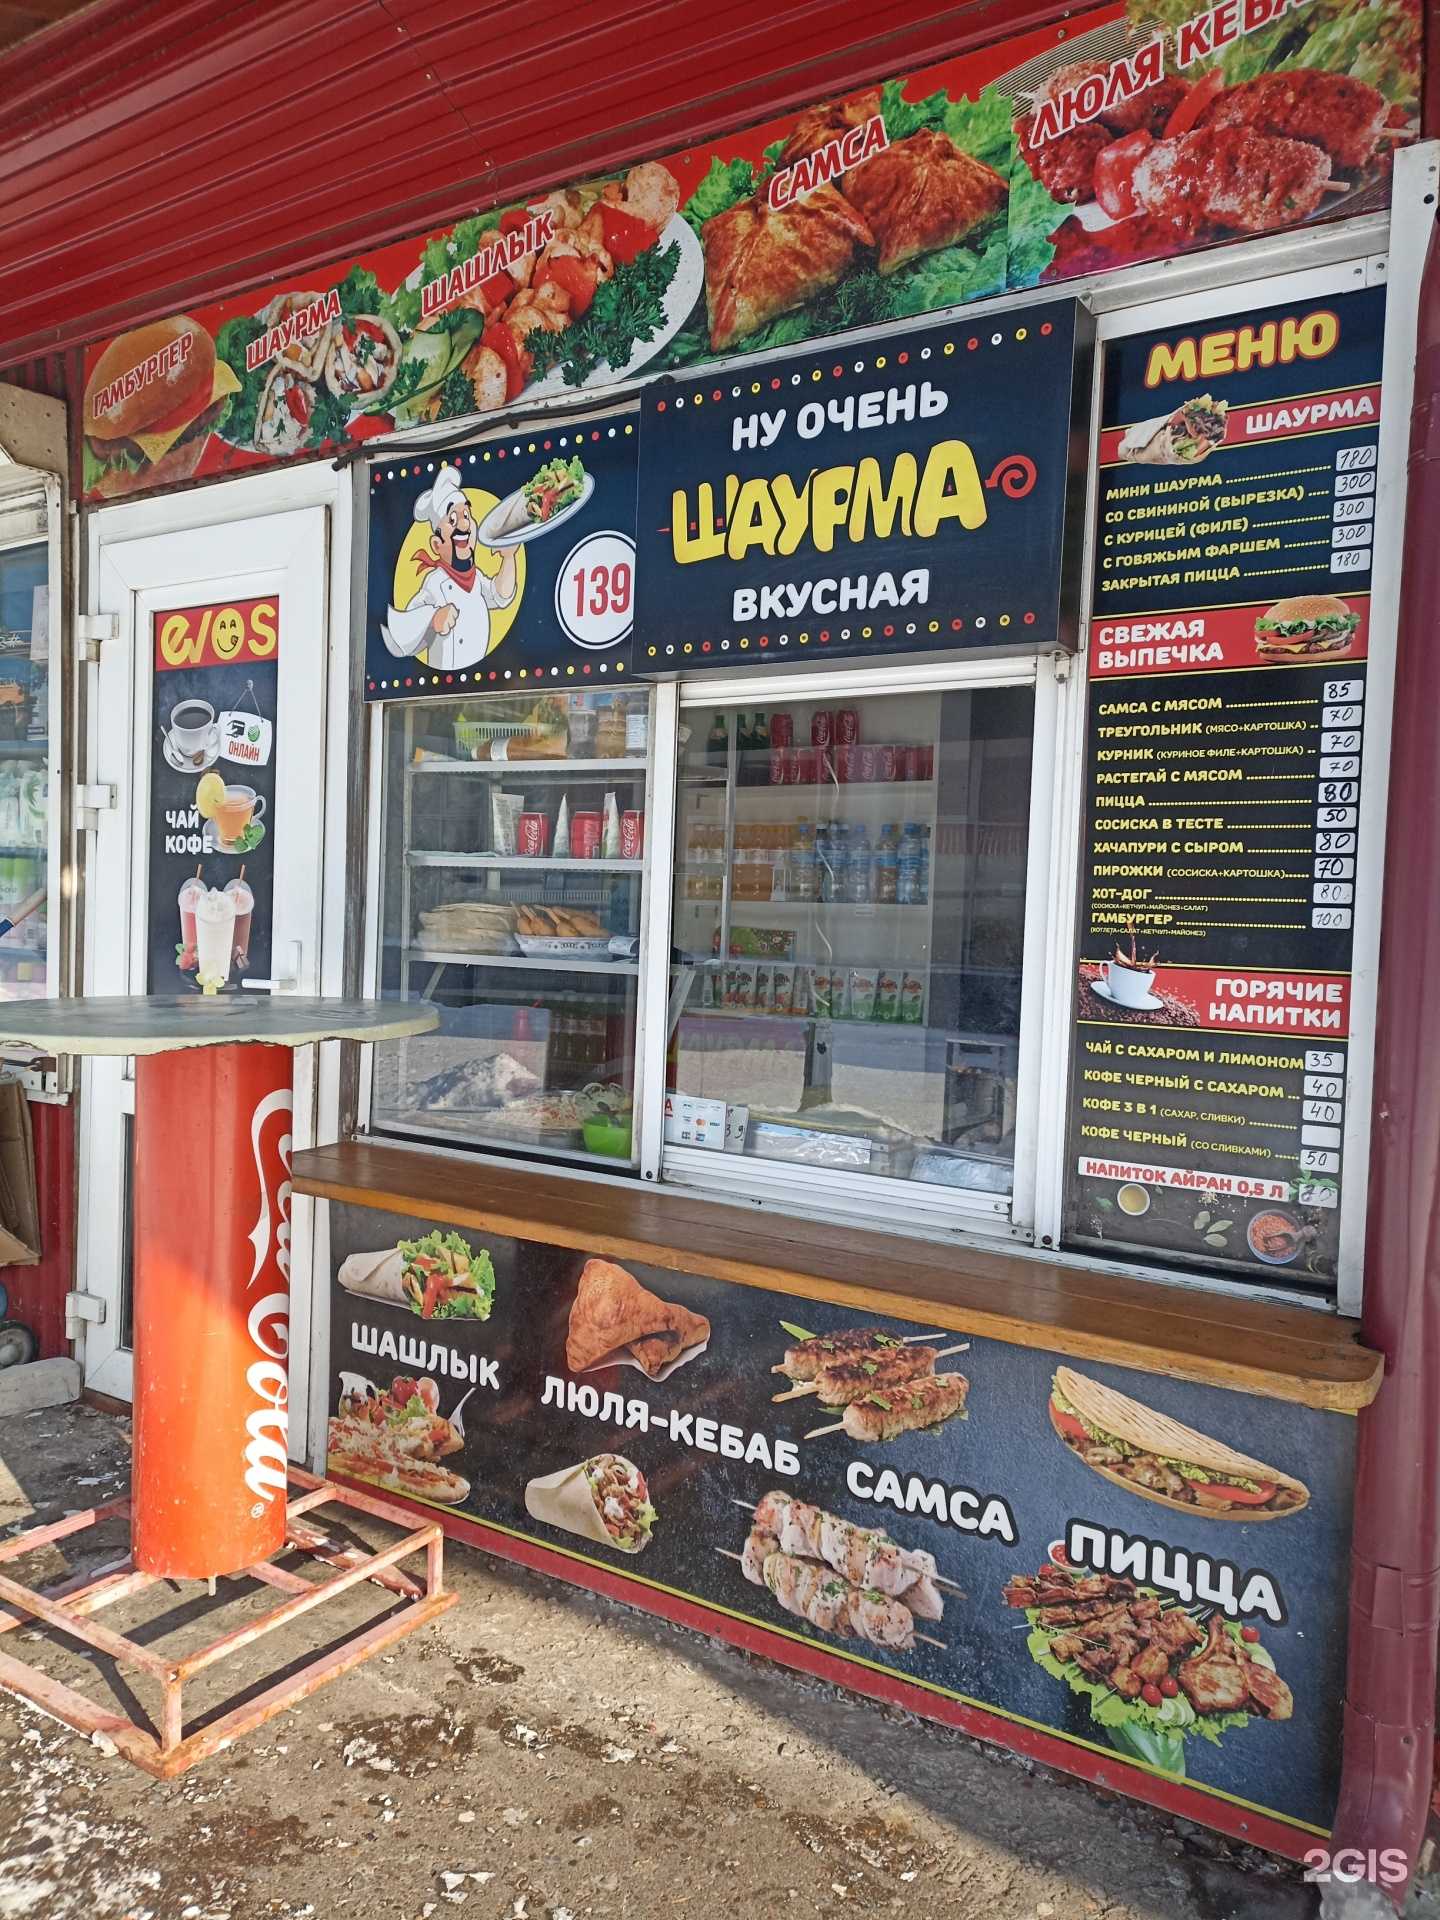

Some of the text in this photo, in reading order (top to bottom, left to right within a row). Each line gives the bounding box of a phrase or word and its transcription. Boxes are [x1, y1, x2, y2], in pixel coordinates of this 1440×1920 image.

[1029, 41, 1164, 148] ЛЮЛЯ
[767, 116, 888, 210] САМСА
[421, 211, 554, 316] ШАШЛЫК
[246, 290, 342, 372] ШАУРМА
[1145, 311, 1338, 388] МЕНЮ
[93, 332, 193, 418] ГАМБУРГЕР
[732, 381, 949, 451] НУ ОЧЕНЬ
[1246, 396, 1374, 434] ШАУРМА
[1106, 448, 1371, 500] МИНИ ШАУРМА 180
[673, 439, 988, 564] ШАУРМА
[1105, 473, 1371, 523] СО СВИНИНОЙ (ВЫРЕЗКА) 300
[1104, 501, 1364, 545] С КУРИЦЕЙ (ФИЛЕ) 300
[1103, 525, 1366, 568] С ГОВЯЖЬИМ ФАРШЕМ 300
[573, 562, 631, 617] 139
[1102, 552, 1360, 591] ЗАКРЫТАЯ ПИЦЦА 180
[732, 568, 929, 622] ВКУСНАЯ
[1099, 619, 1205, 645] СВЕЖАЯ
[1098, 642, 1224, 669] ВЫПЕЧКА
[1099, 682, 1351, 715] САМСА С МЯСОМ 85
[1097, 707, 1354, 738] ТРЕУГОЛЬНИК (МЯСО+КАРТОШКА) 70
[228, 740, 260, 762] ОНЛАЙН
[1097, 734, 1355, 761] КУРНИК (КУРИНОЕ ФИЛЕ+КАРТОШКА) 70
[1096, 760, 1354, 784] РАСТЕГАЙ С МЯСОМ 70
[1096, 783, 1352, 808] ПИЦЦА 80
[165, 804, 200, 829] ЧАЙ
[1095, 808, 1347, 830] СОСИСКА В ТЕСТЕ 50
[165, 835, 214, 854] КОФЕ
[1094, 833, 1350, 853] ХАЧАПУРИ С СЫРОМ 80
[1094, 858, 1344, 879] ПИРОЖКИ (СОСИСКА+КАРТОШКА) 70
[1092, 885, 1342, 901] ХОТ-ДОГ 80
[1091, 912, 1343, 926] ГАМБУРГЕР 100
[1215, 978, 1343, 1004] ГОРЯЧИЕ
[1209, 1002, 1341, 1029] НАПИТКИ
[1086, 1040, 1333, 1070] ЧАЙ С САХАРОМ И ЛИМОНОМ 35
[1084, 1070, 1337, 1098] КОФЕ ЧЕРНЫЙ С САХАРОМ 40
[1082, 1097, 1120, 1111] КОФЕ
[1124, 1102, 1133, 1112] 3
[1137, 1103, 1146, 1114] В
[1150, 1105, 1157, 1115] 1
[1200, 1112, 1246, 1126] СЛИВКИ)
[1311, 1103, 1334, 1121] 40
[1081, 1125, 1327, 1166] КОФЕ ЧЕРНЫЙ (СО СЛИВКАМИ) 50
[1086, 1161, 1166, 1184] НАПИТОК
[1170, 1168, 1232, 1191] АЙРАН
[1237, 1181, 1264, 1197] 0,5
[1270, 1185, 1283, 1198] Л
[351, 1322, 501, 1390] ШАШЛЫК
[541, 1375, 801, 1477] ЛЮЛЯ-КЕБАБ
[846, 1461, 1014, 1542] САМСА
[1070, 1524, 1284, 1622] ПИЦЦА
